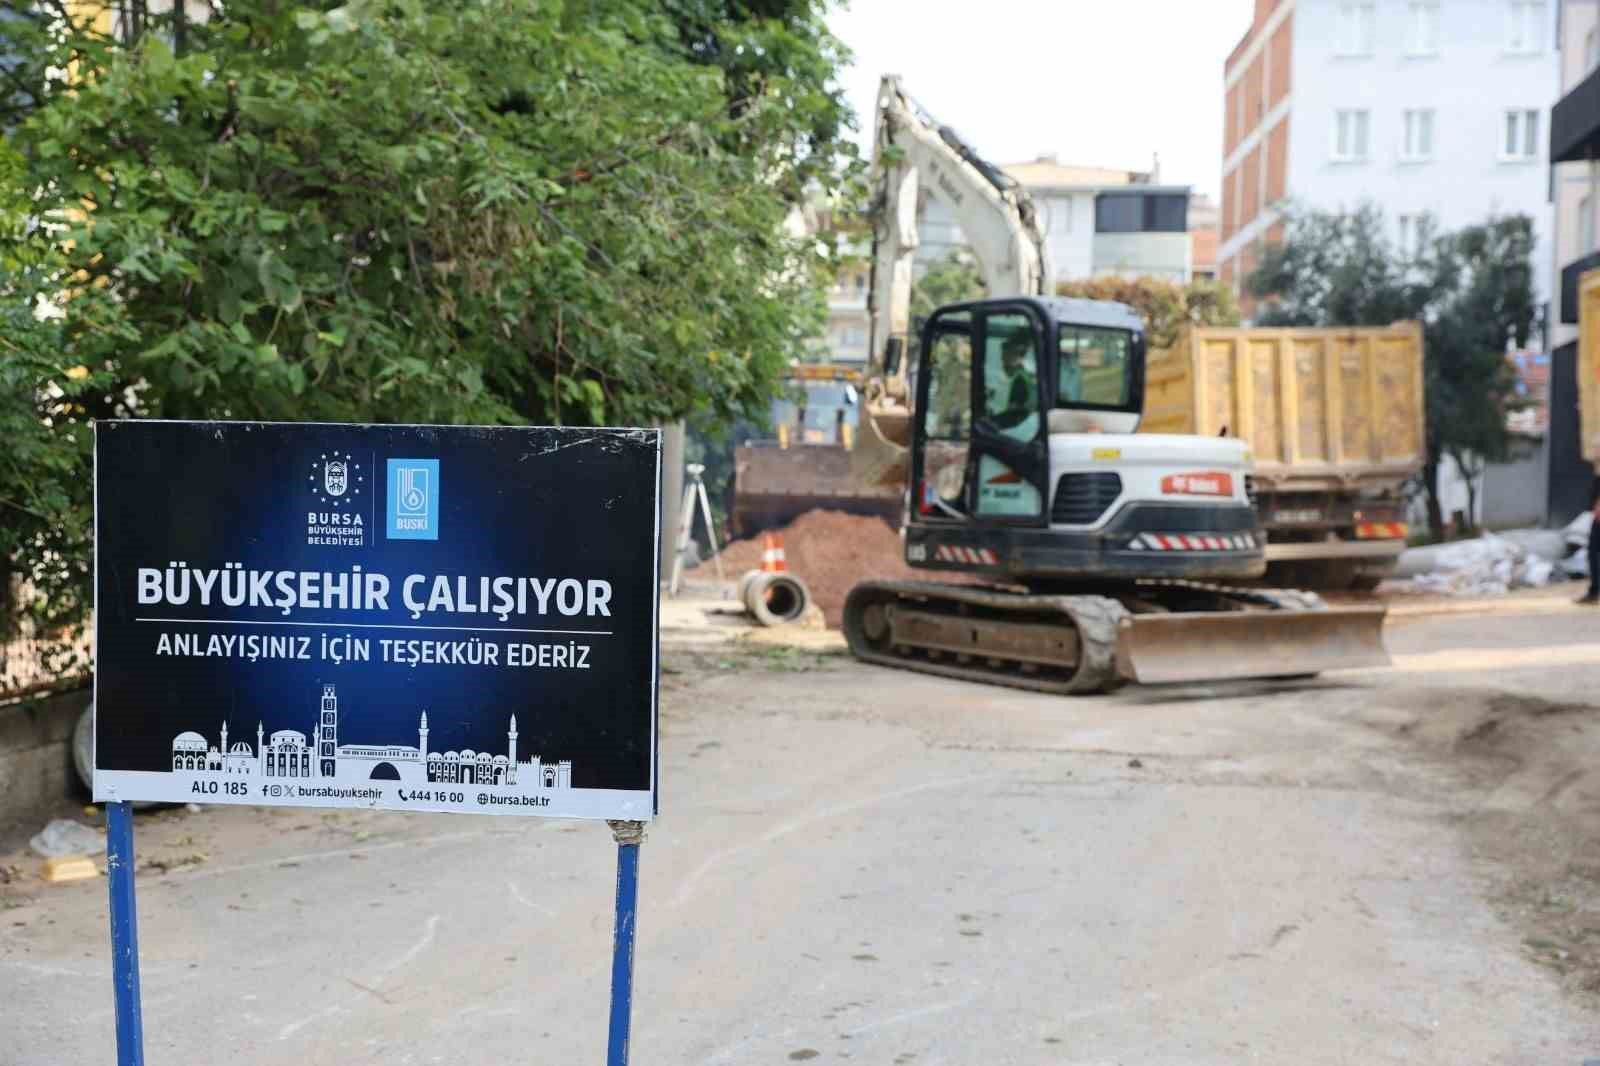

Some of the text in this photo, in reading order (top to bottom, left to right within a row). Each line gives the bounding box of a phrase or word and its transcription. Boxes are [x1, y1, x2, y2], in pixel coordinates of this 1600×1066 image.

[308, 512, 363, 525] BURSA
[307, 535, 363, 546] BELEDİYESİ
[138, 561, 613, 621] BÜYÜKŞEHİR ÇALIŞIYOR
[156, 633, 591, 669] ANLAYIŞINIZ İÇİN TEŞEKKÜR EDERİZ
[191, 781, 248, 796] ALO 185
[408, 790, 464, 803] 444 16 00
[489, 793, 550, 807] bursa.bel.tr
